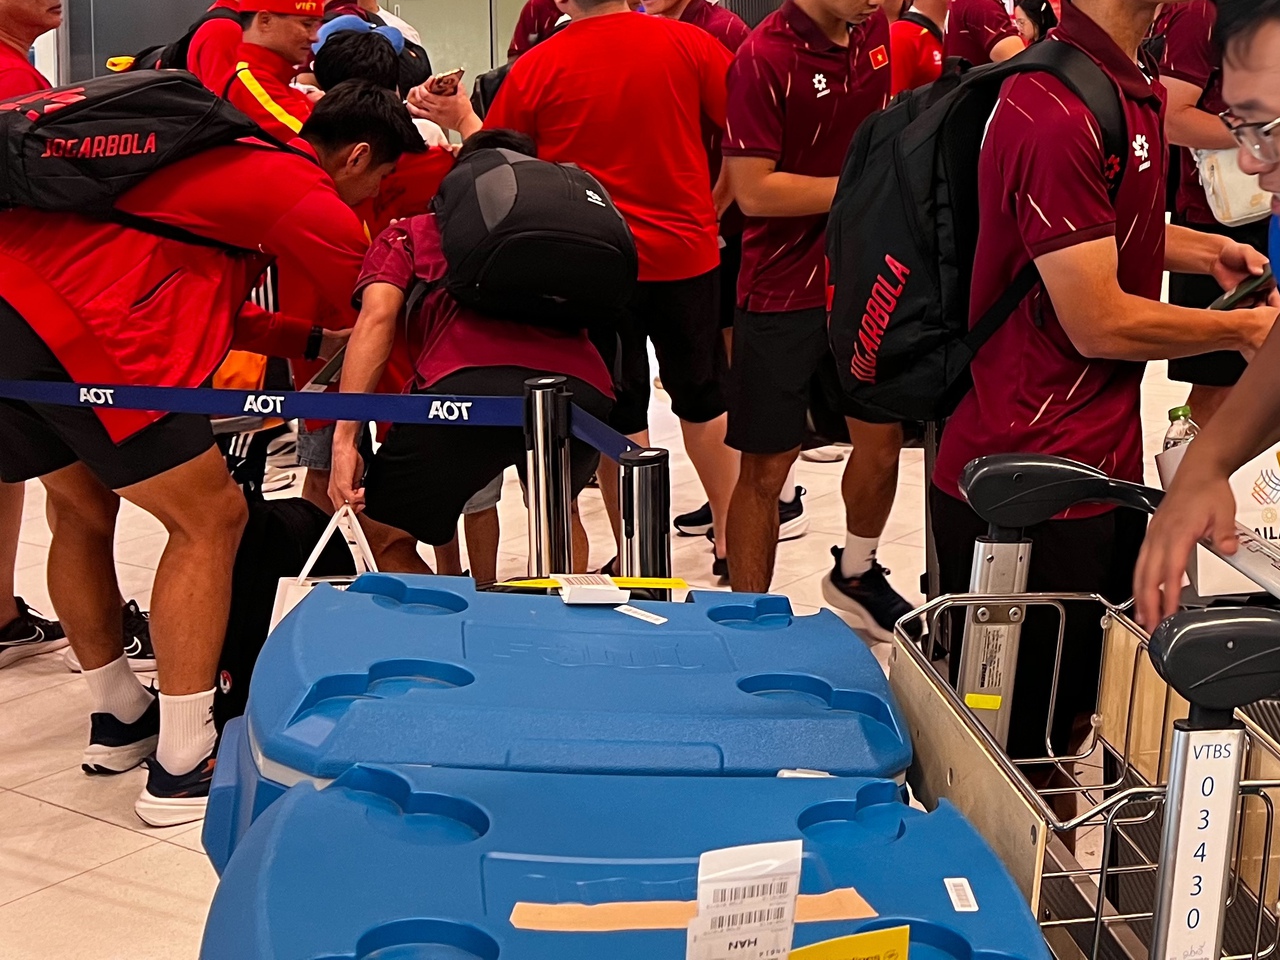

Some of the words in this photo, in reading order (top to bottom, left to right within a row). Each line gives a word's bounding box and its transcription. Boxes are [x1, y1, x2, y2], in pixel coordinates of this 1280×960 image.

[41, 132, 156, 158] JOGARBOLA
[851, 253, 911, 385] JOGARBOLA
[79, 387, 114, 405] AOT
[243, 394, 285, 414] AOT
[428, 400, 472, 421] AOT
[1193, 743, 1231, 760] VTBS
[728, 937, 758, 951] HAN
